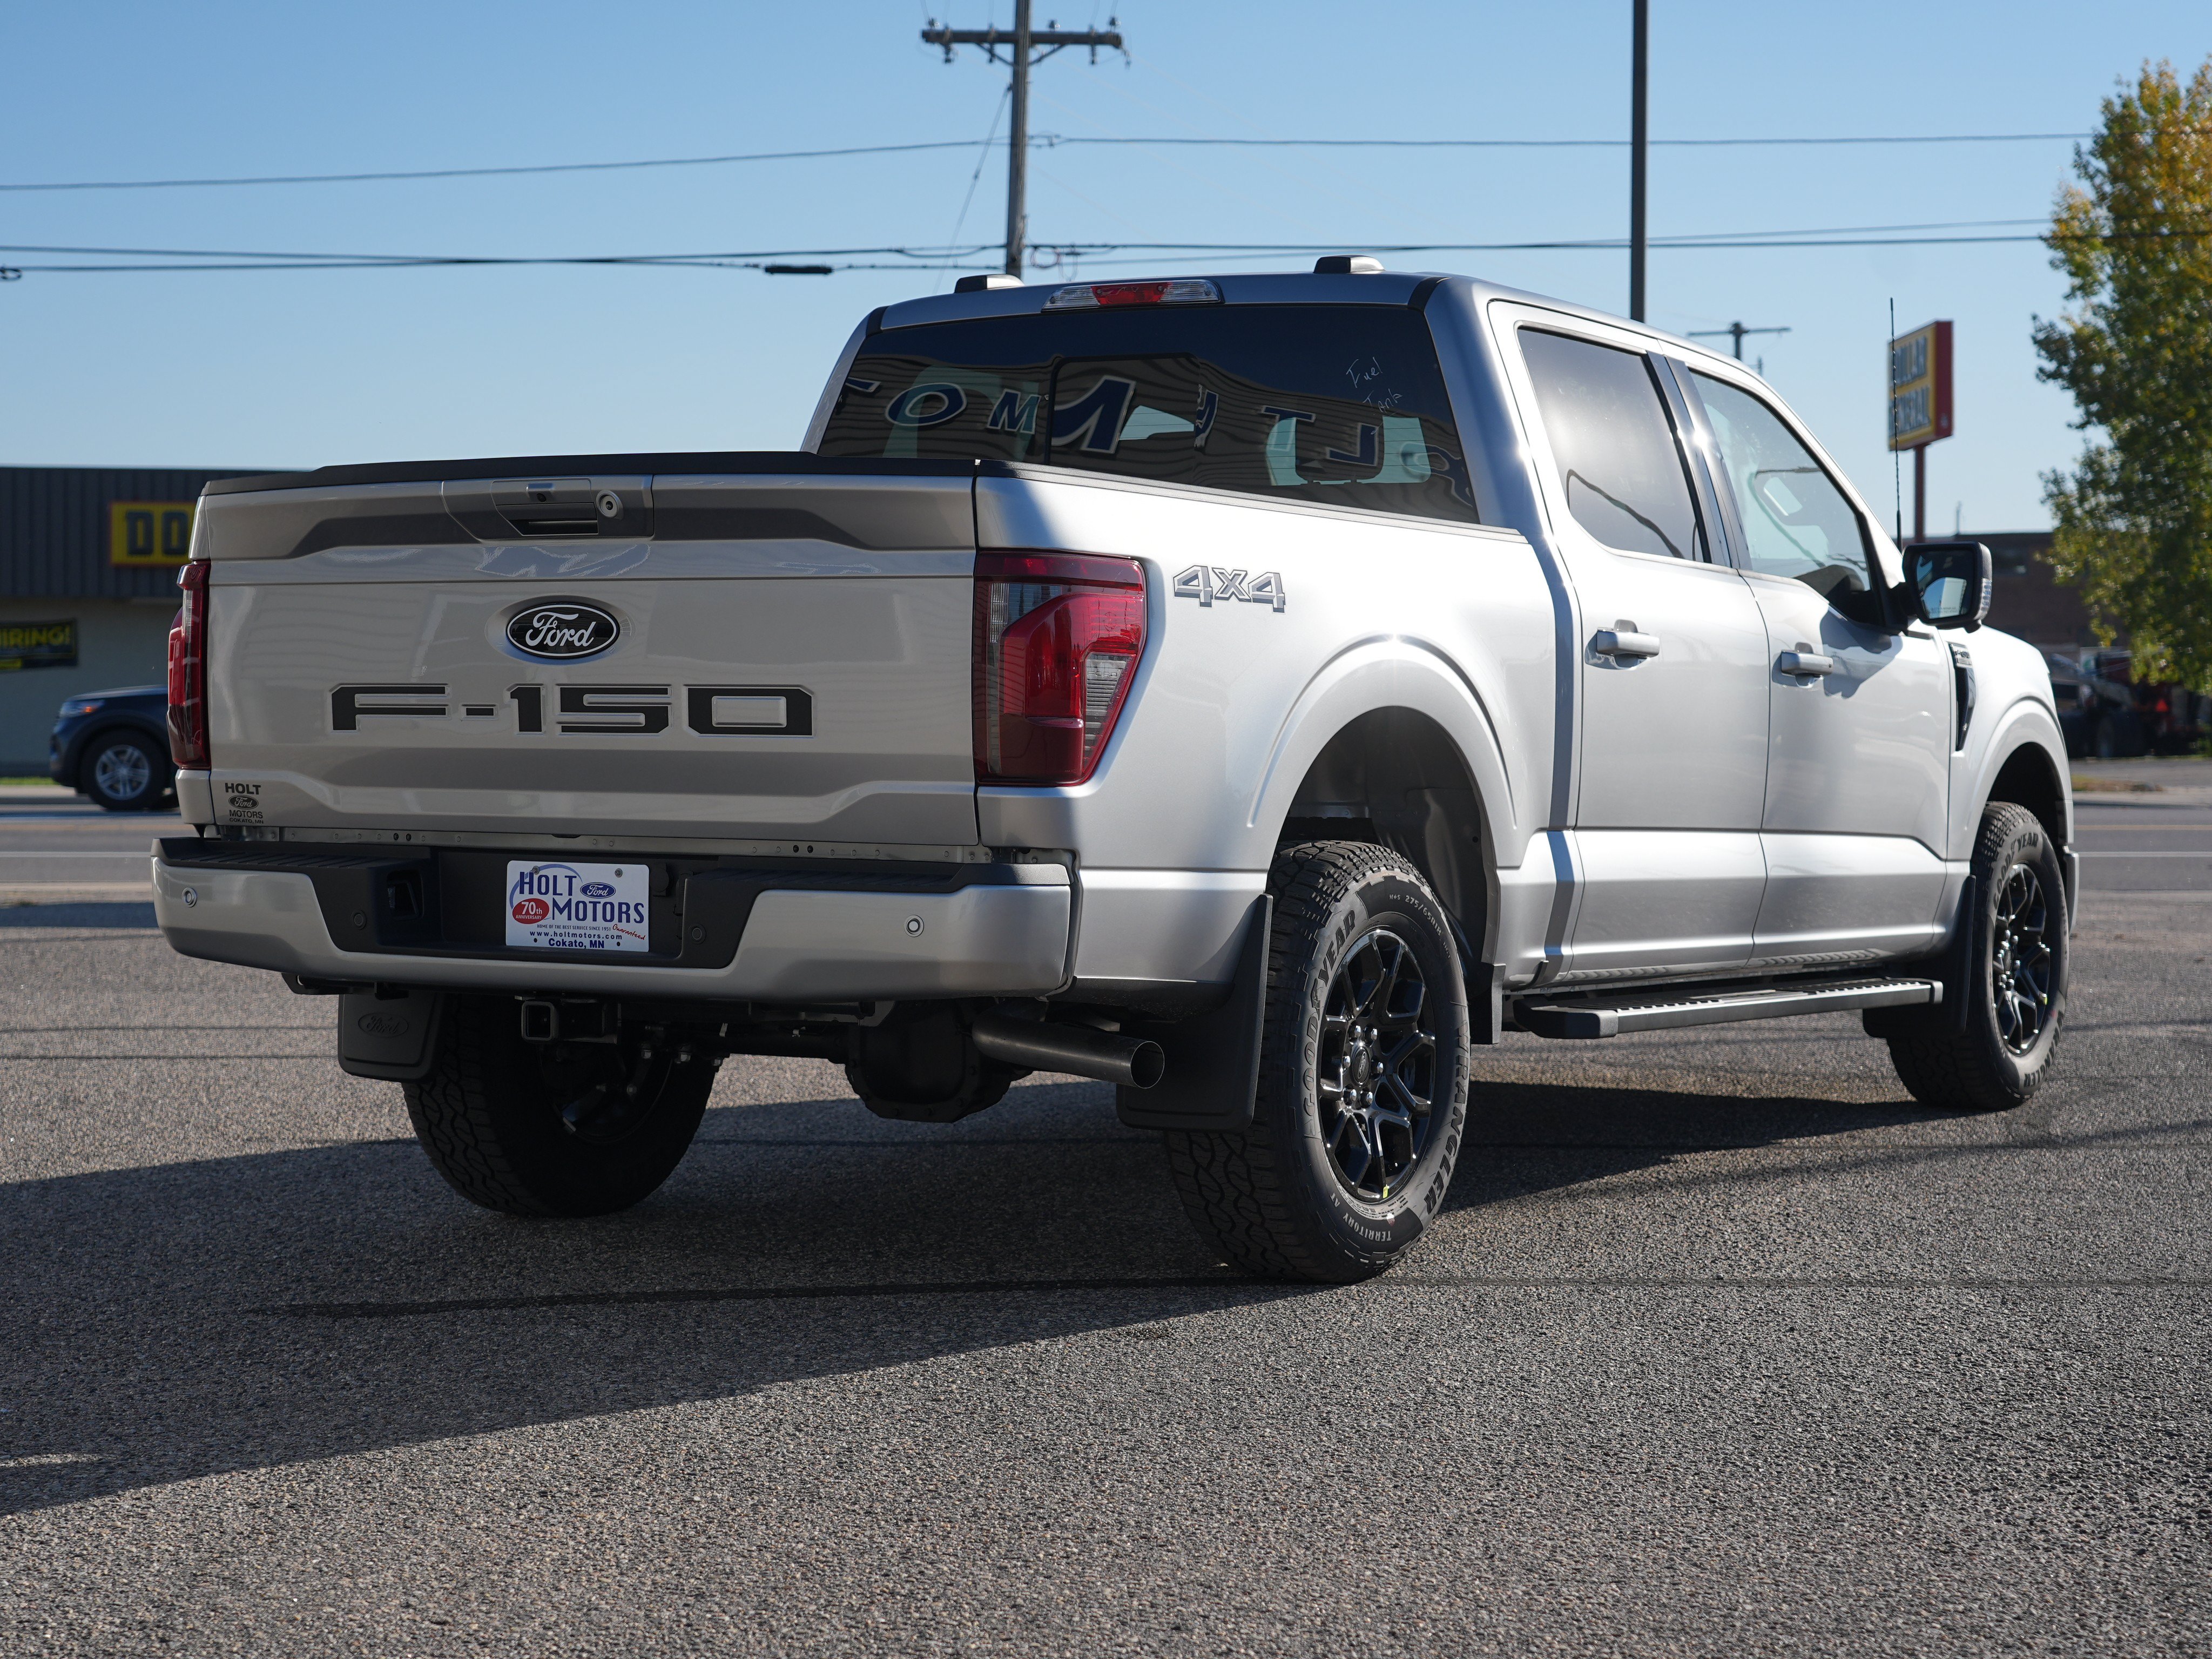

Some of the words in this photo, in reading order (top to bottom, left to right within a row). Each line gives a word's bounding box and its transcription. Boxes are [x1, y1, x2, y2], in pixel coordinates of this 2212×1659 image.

[1346, 356, 1382, 388] Fuel
[0, 625, 70, 647] IRING!
[525, 611, 597, 648] Ford
[330, 684, 814, 738] F-150
[225, 783, 261, 795] HOLT
[234, 797, 253, 807] Ford
[229, 810, 263, 819] MOTORS
[519, 872, 577, 896] HOLT
[587, 885, 609, 896] Ford
[521, 901, 542, 915] 70th
[552, 897, 644, 923] MOTORS
[1405, 895, 1442, 936] 275/65R18
[530, 930, 622, 940] www.holtmotors.com
[612, 923, 646, 940] Guaranteed
[548, 938, 586, 949] Cokato,
[589, 940, 605, 948] MN
[1303, 909, 1355, 1116] GOODYEAR
[1424, 1022, 1469, 1216] WRANGLER
[1330, 1192, 1340, 1208] AT
[1343, 1212, 1392, 1242] TERRITORY
